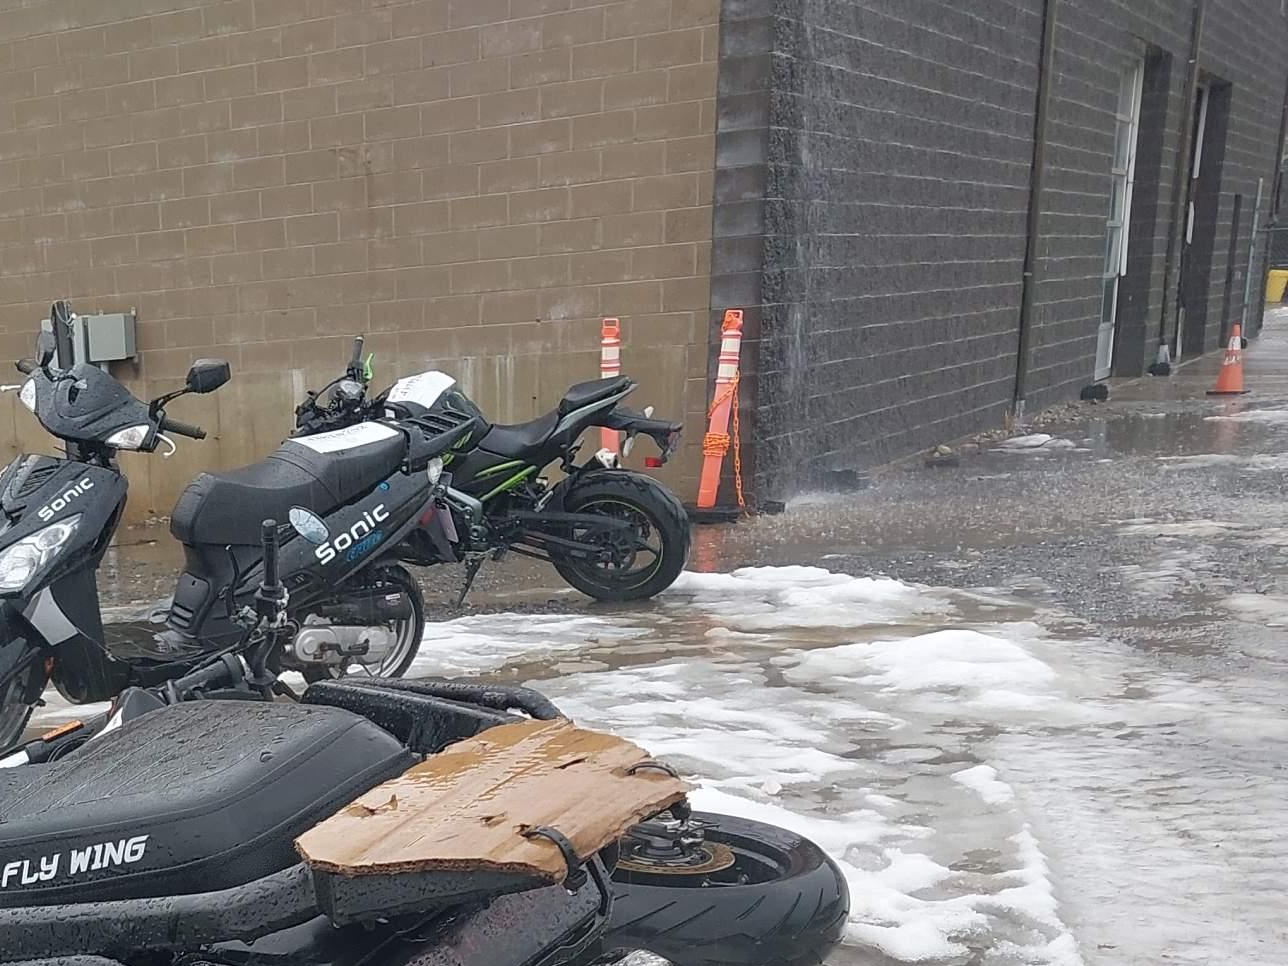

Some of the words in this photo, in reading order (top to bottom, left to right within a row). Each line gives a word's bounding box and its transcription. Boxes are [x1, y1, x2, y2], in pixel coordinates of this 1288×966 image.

[314, 504, 390, 566] Sonic
[1, 853, 62, 888] FLY
[70, 834, 150, 875] WING
